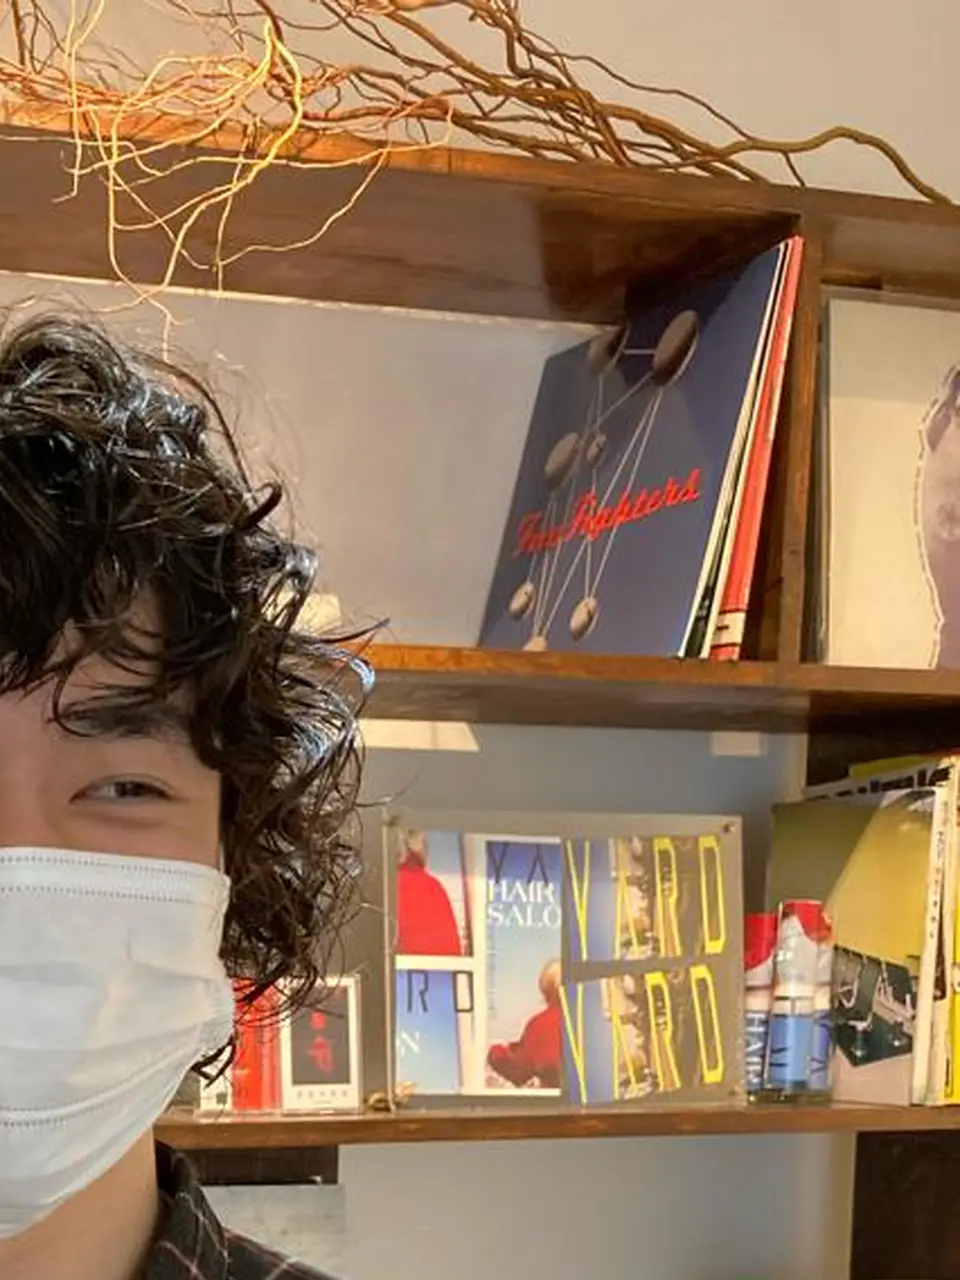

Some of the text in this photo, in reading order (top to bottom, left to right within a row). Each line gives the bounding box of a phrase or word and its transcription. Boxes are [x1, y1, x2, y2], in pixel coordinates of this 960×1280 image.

[488, 880, 556, 905] HAIR
[488, 904, 562, 929] SALO
[567, 836, 725, 962] YARD
[559, 965, 724, 1104] YARD
